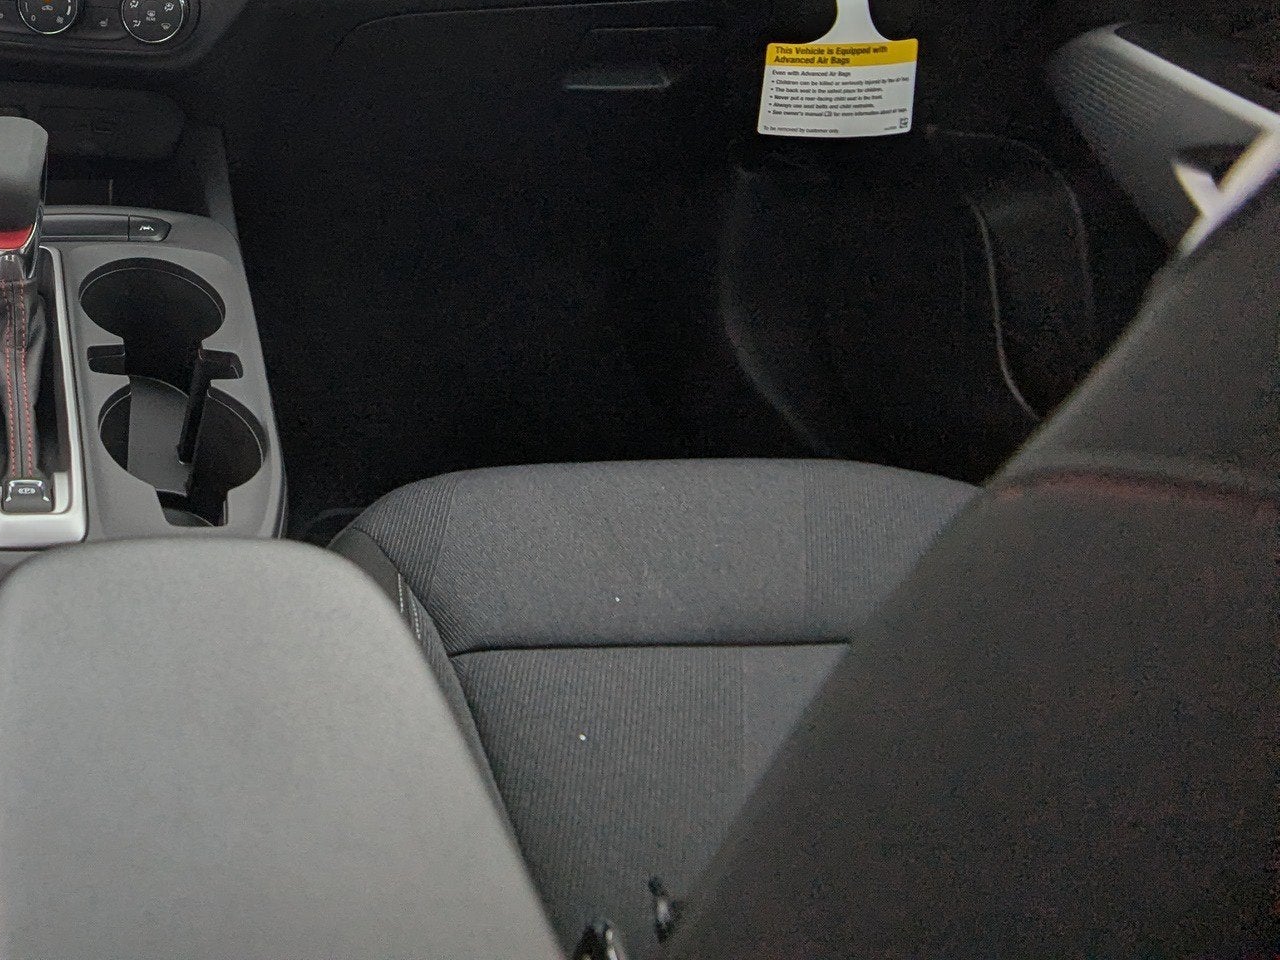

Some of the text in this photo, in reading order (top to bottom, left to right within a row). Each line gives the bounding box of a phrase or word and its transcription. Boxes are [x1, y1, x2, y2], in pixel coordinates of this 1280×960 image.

[776, 46, 792, 54] This
[836, 47, 871, 56] Equipped
[774, 56, 815, 64] Advanced
[830, 56, 850, 65] Bags
